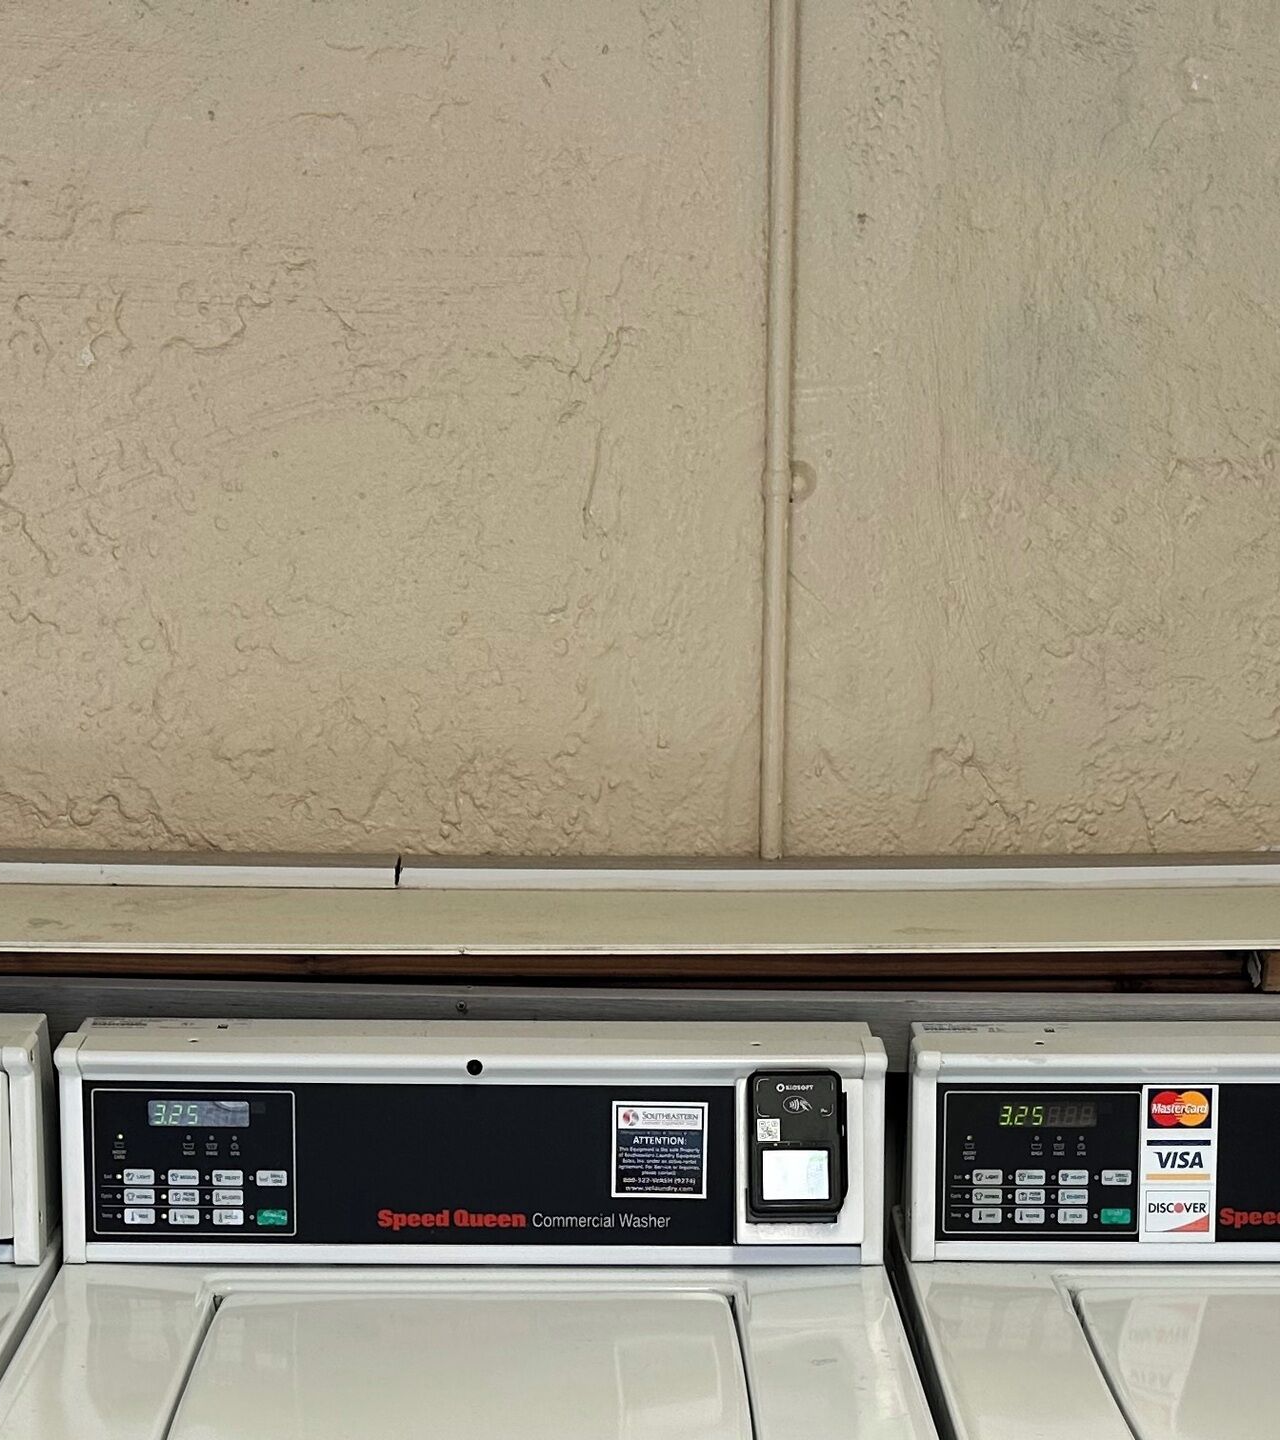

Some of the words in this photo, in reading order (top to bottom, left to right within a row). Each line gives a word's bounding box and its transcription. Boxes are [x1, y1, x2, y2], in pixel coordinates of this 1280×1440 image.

[153, 1104, 198, 1125] 3.25
[642, 1111, 699, 1121] SOUTHEASTERN
[998, 1106, 1044, 1126] 3.25
[1151, 1103, 1208, 1115] MasterCard
[633, 1136, 687, 1145] ATTENTION:
[1153, 1151, 1204, 1169] VISA
[1148, 1202, 1207, 1213] DISCOVER
[377, 1209, 449, 1230] Speed
[453, 1209, 526, 1227] Queen
[532, 1212, 615, 1228] Commercial
[619, 1213, 671, 1228] Washer
